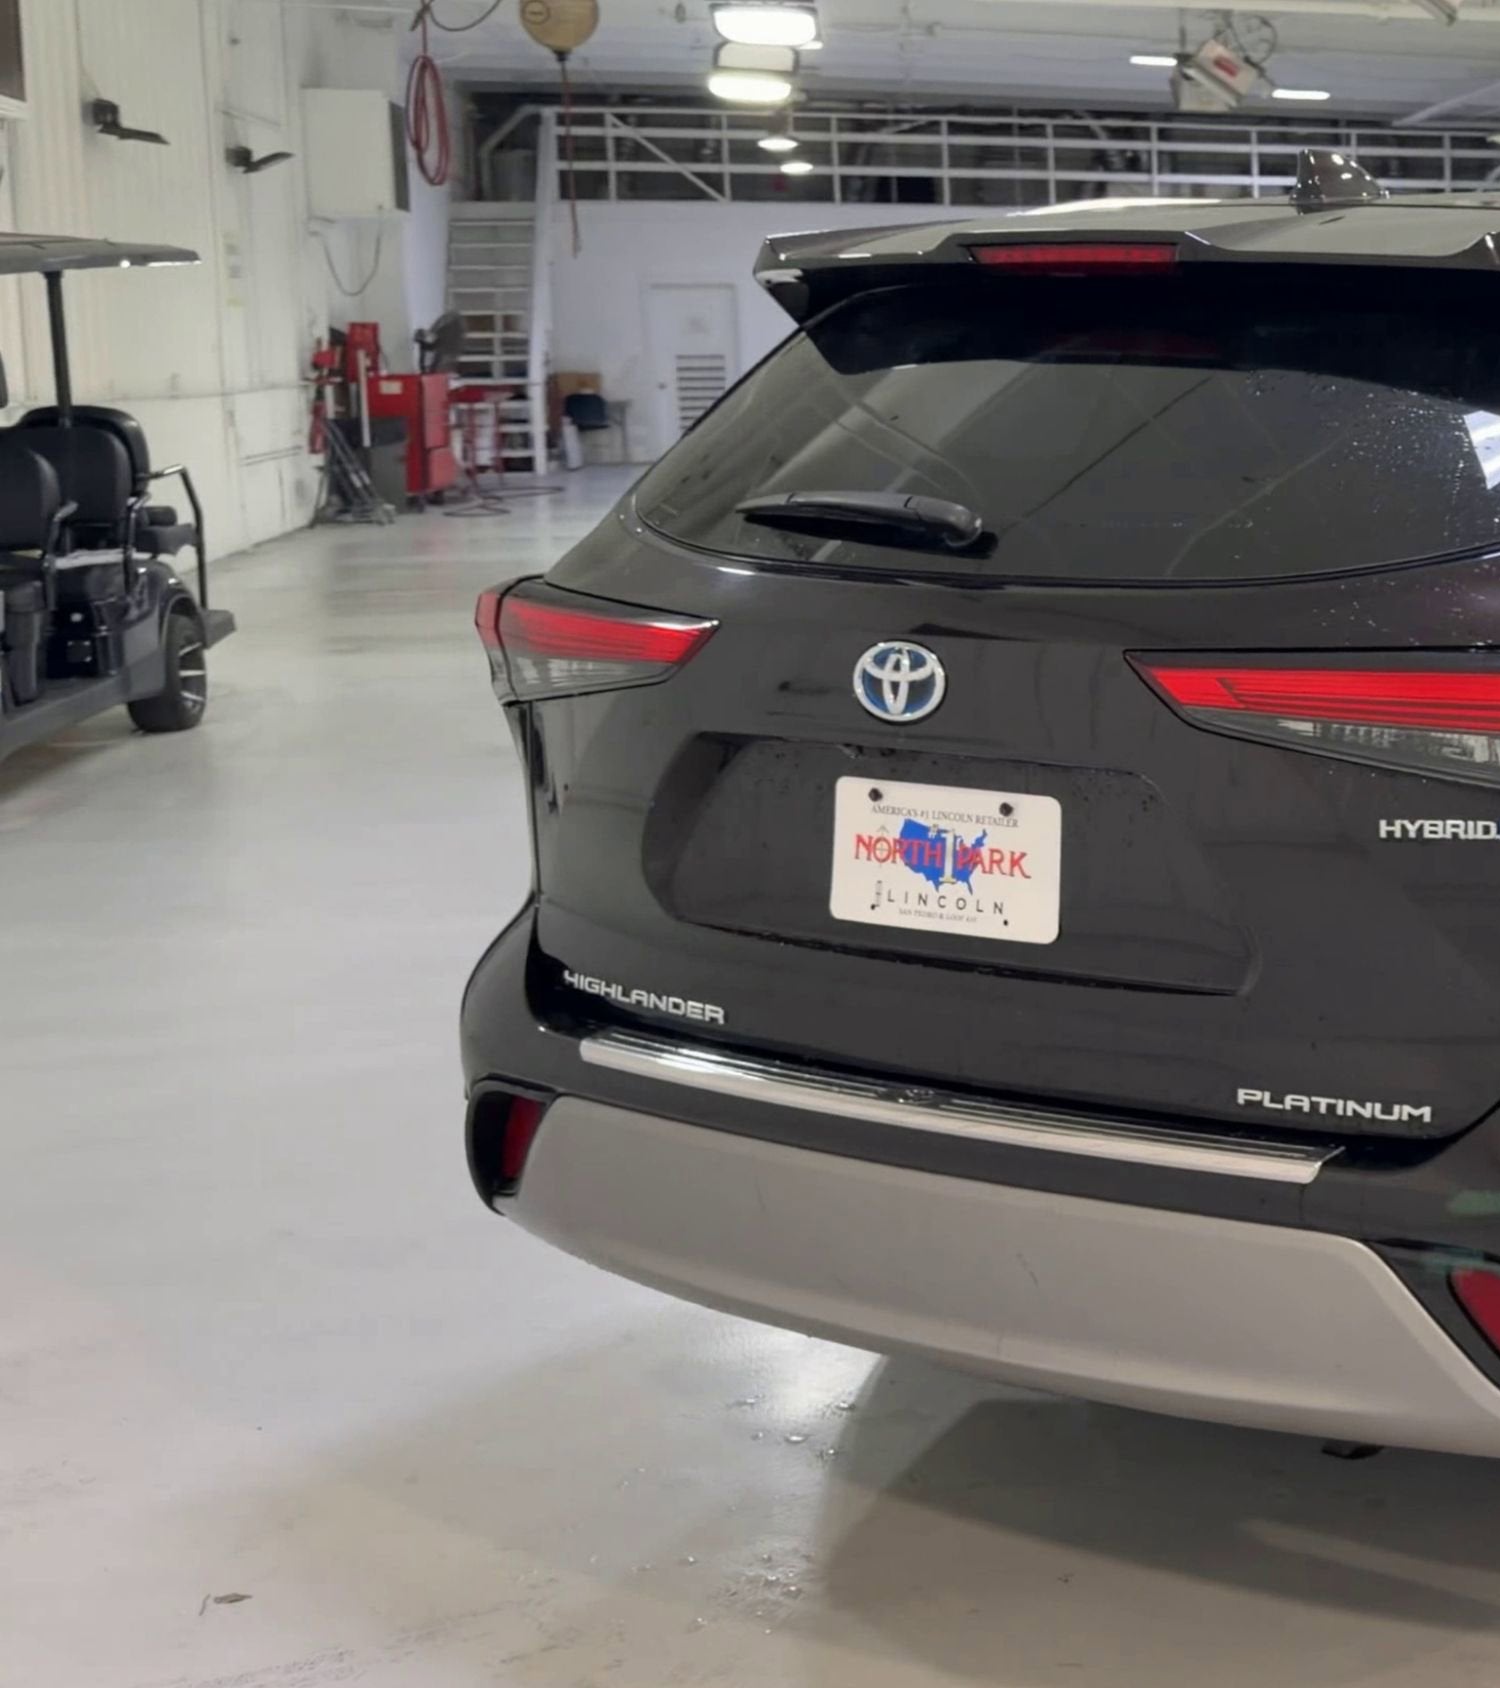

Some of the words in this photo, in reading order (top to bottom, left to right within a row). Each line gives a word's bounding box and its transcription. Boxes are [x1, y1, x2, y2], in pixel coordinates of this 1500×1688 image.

[872, 804, 917, 818] AMERICA'S
[932, 810, 973, 823] LINCOLN
[975, 815, 1018, 828] RETAILER
[1380, 819, 1497, 840] HYBRID
[855, 833, 942, 868] NORTH
[957, 843, 1031, 878] PARK
[887, 889, 1003, 914] LINCOLN
[563, 969, 725, 1025] HIGHLANDER
[1237, 1088, 1431, 1123] PLATINUM
